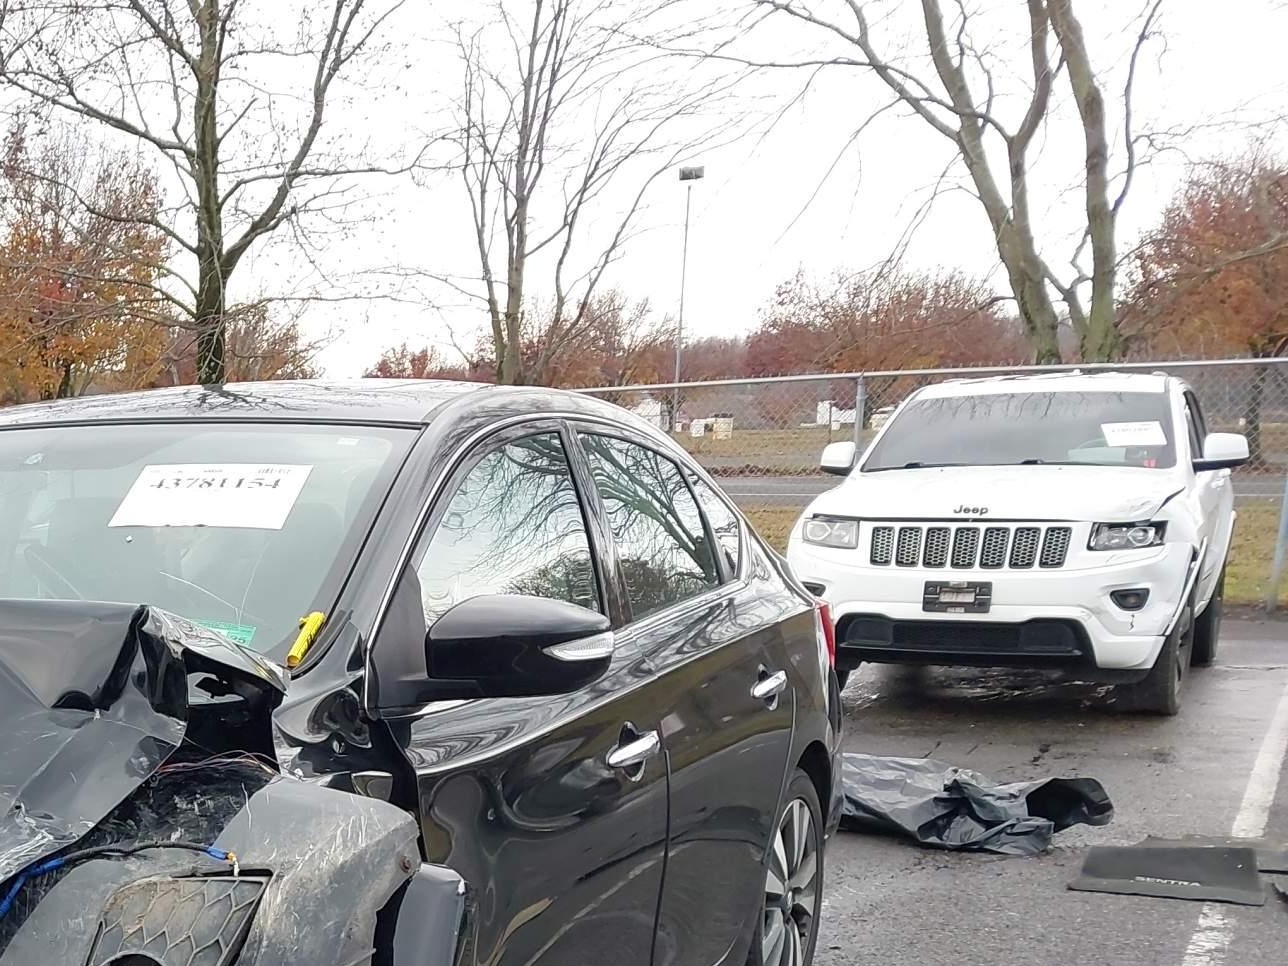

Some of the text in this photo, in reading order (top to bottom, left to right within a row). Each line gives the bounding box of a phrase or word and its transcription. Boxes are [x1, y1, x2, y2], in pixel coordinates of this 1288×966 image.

[150, 477, 281, 489] 43781154
[953, 504, 989, 516] Jeep
[1135, 877, 1201, 887] SENTRA
